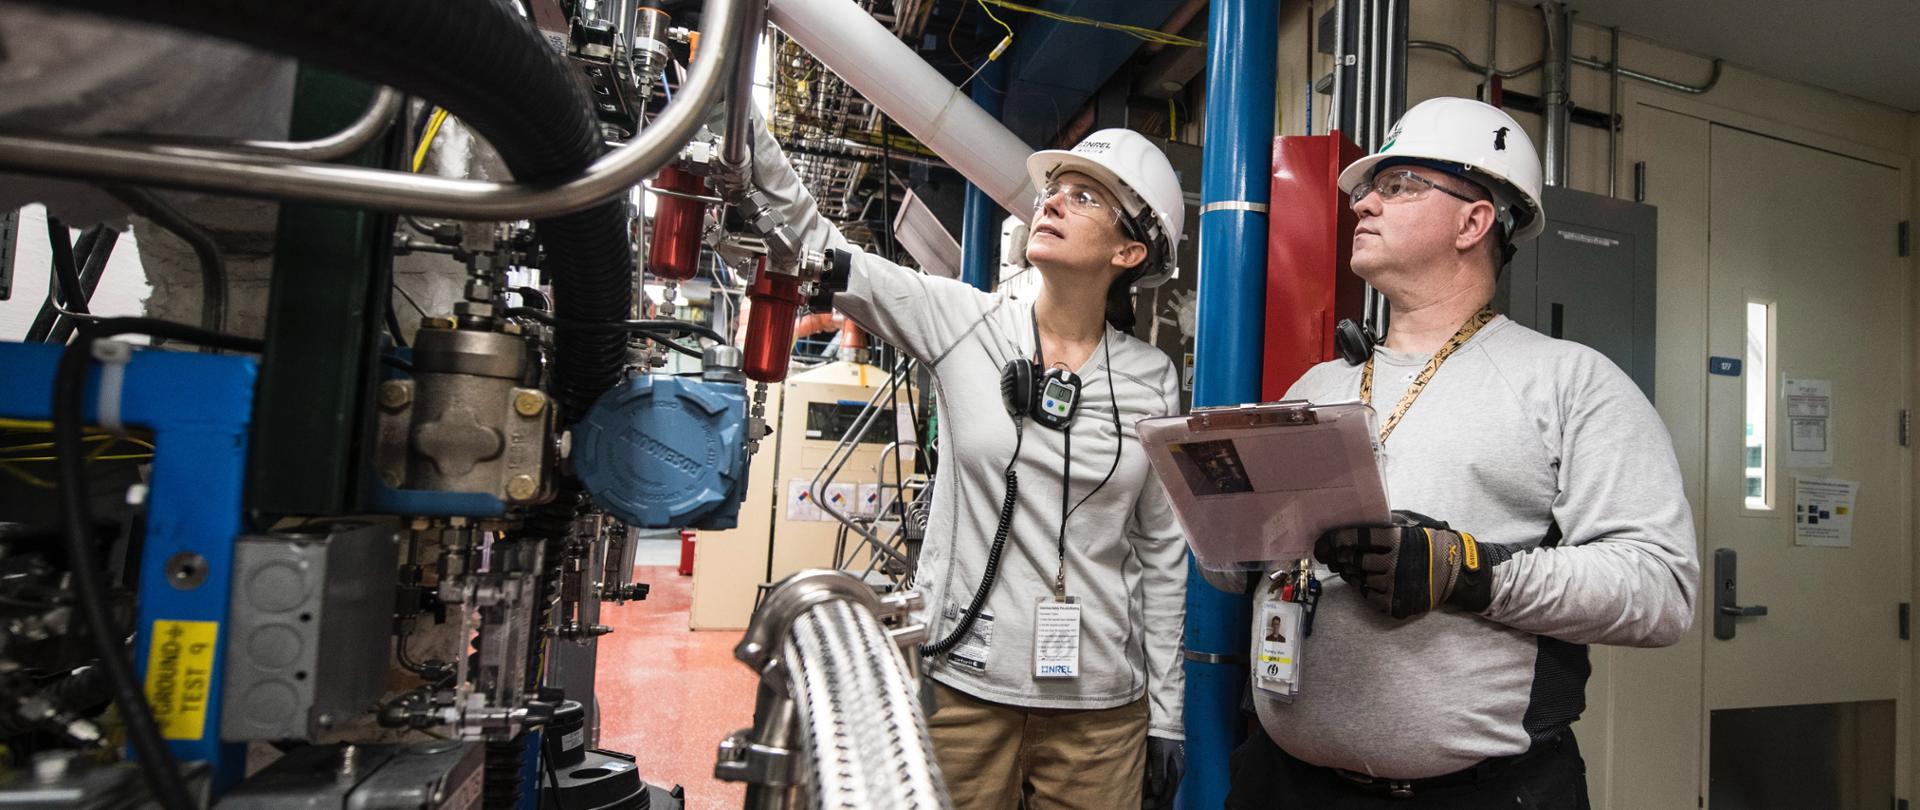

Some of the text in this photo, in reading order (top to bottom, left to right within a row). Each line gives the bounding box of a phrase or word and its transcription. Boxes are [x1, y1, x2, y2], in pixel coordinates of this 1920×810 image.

[619, 426, 702, 478] ROSEMOUNT
[180, 667, 208, 713] TEST
[1048, 665, 1073, 674] NREL
